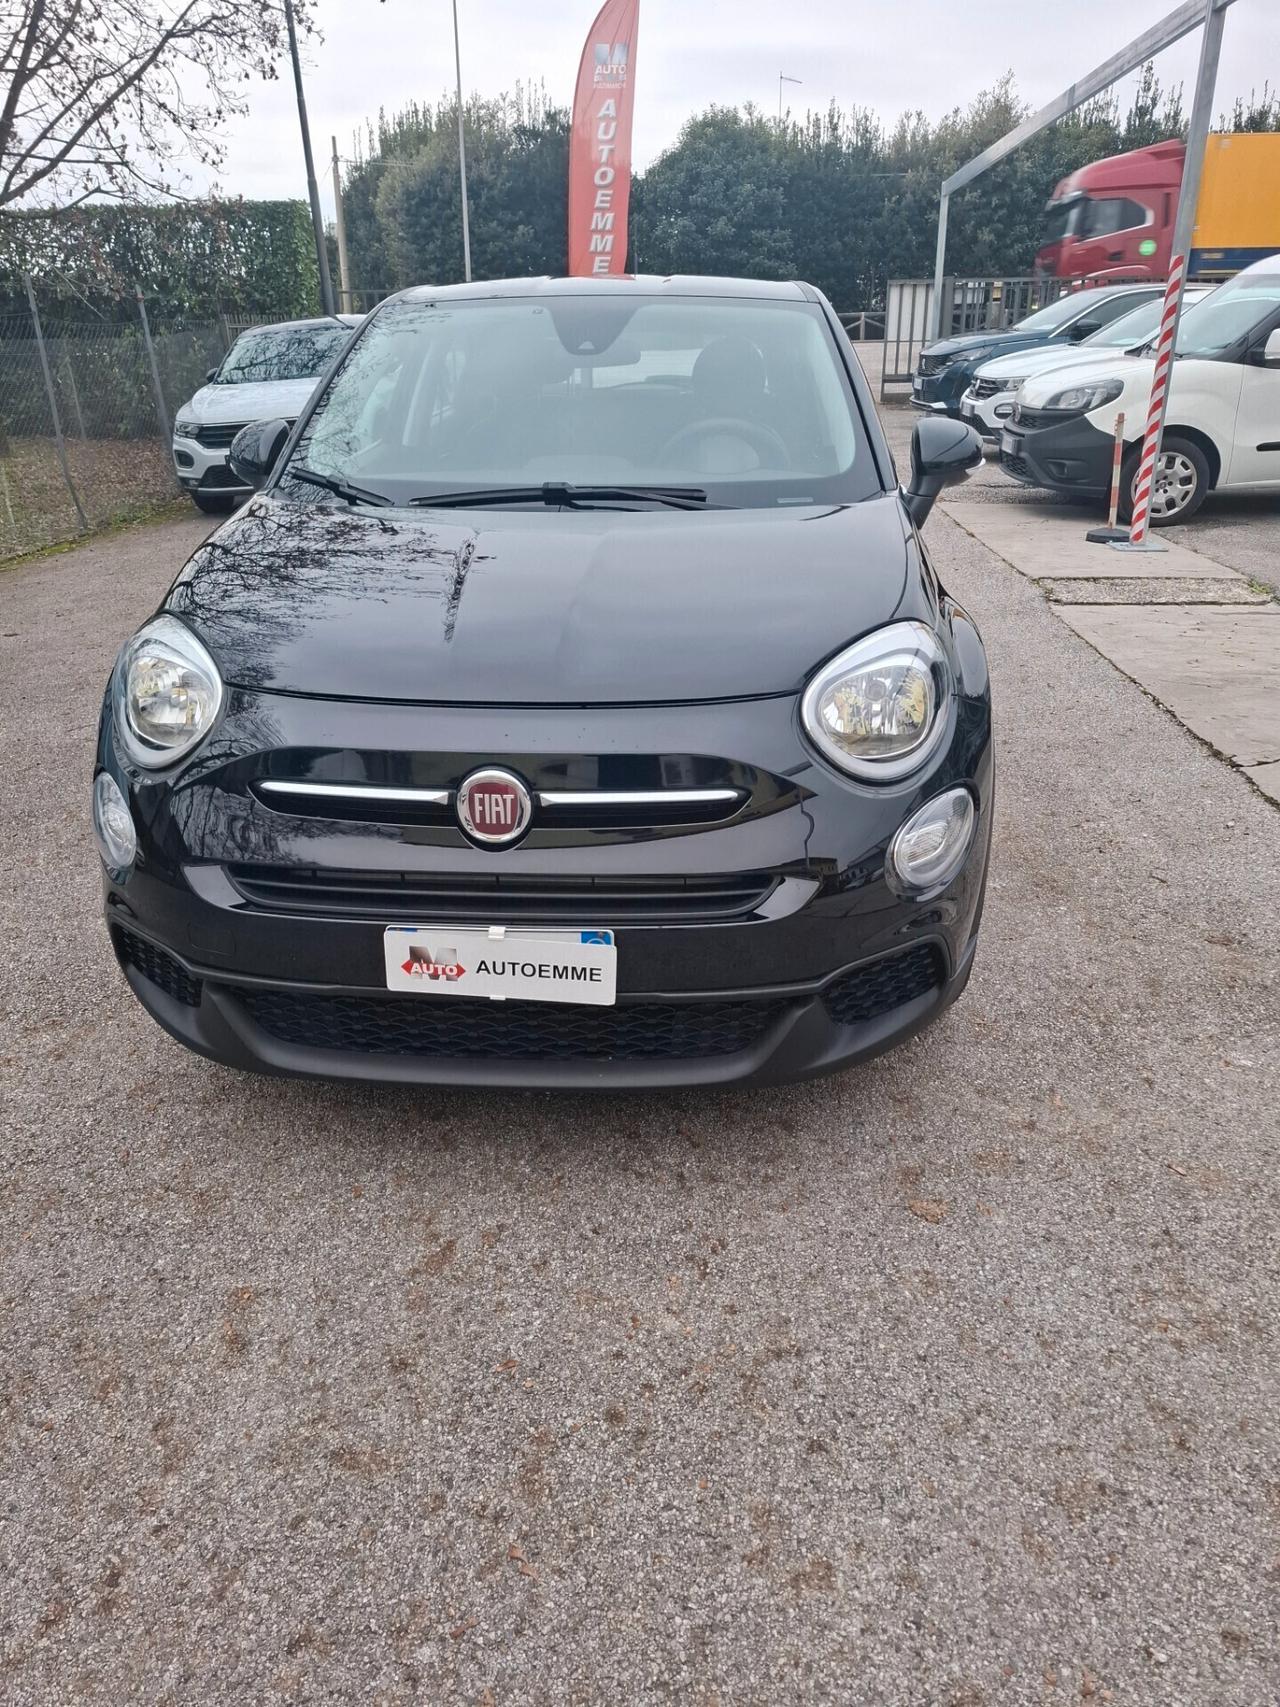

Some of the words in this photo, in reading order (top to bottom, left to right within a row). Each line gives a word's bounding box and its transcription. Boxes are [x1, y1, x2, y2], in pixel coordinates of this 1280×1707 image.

[595, 64, 627, 74] AUTO
[589, 98, 617, 275] AUTOEMME
[474, 793, 515, 825] FIAT
[410, 961, 458, 976] AUTO
[476, 960, 603, 982] AUTOEMME
